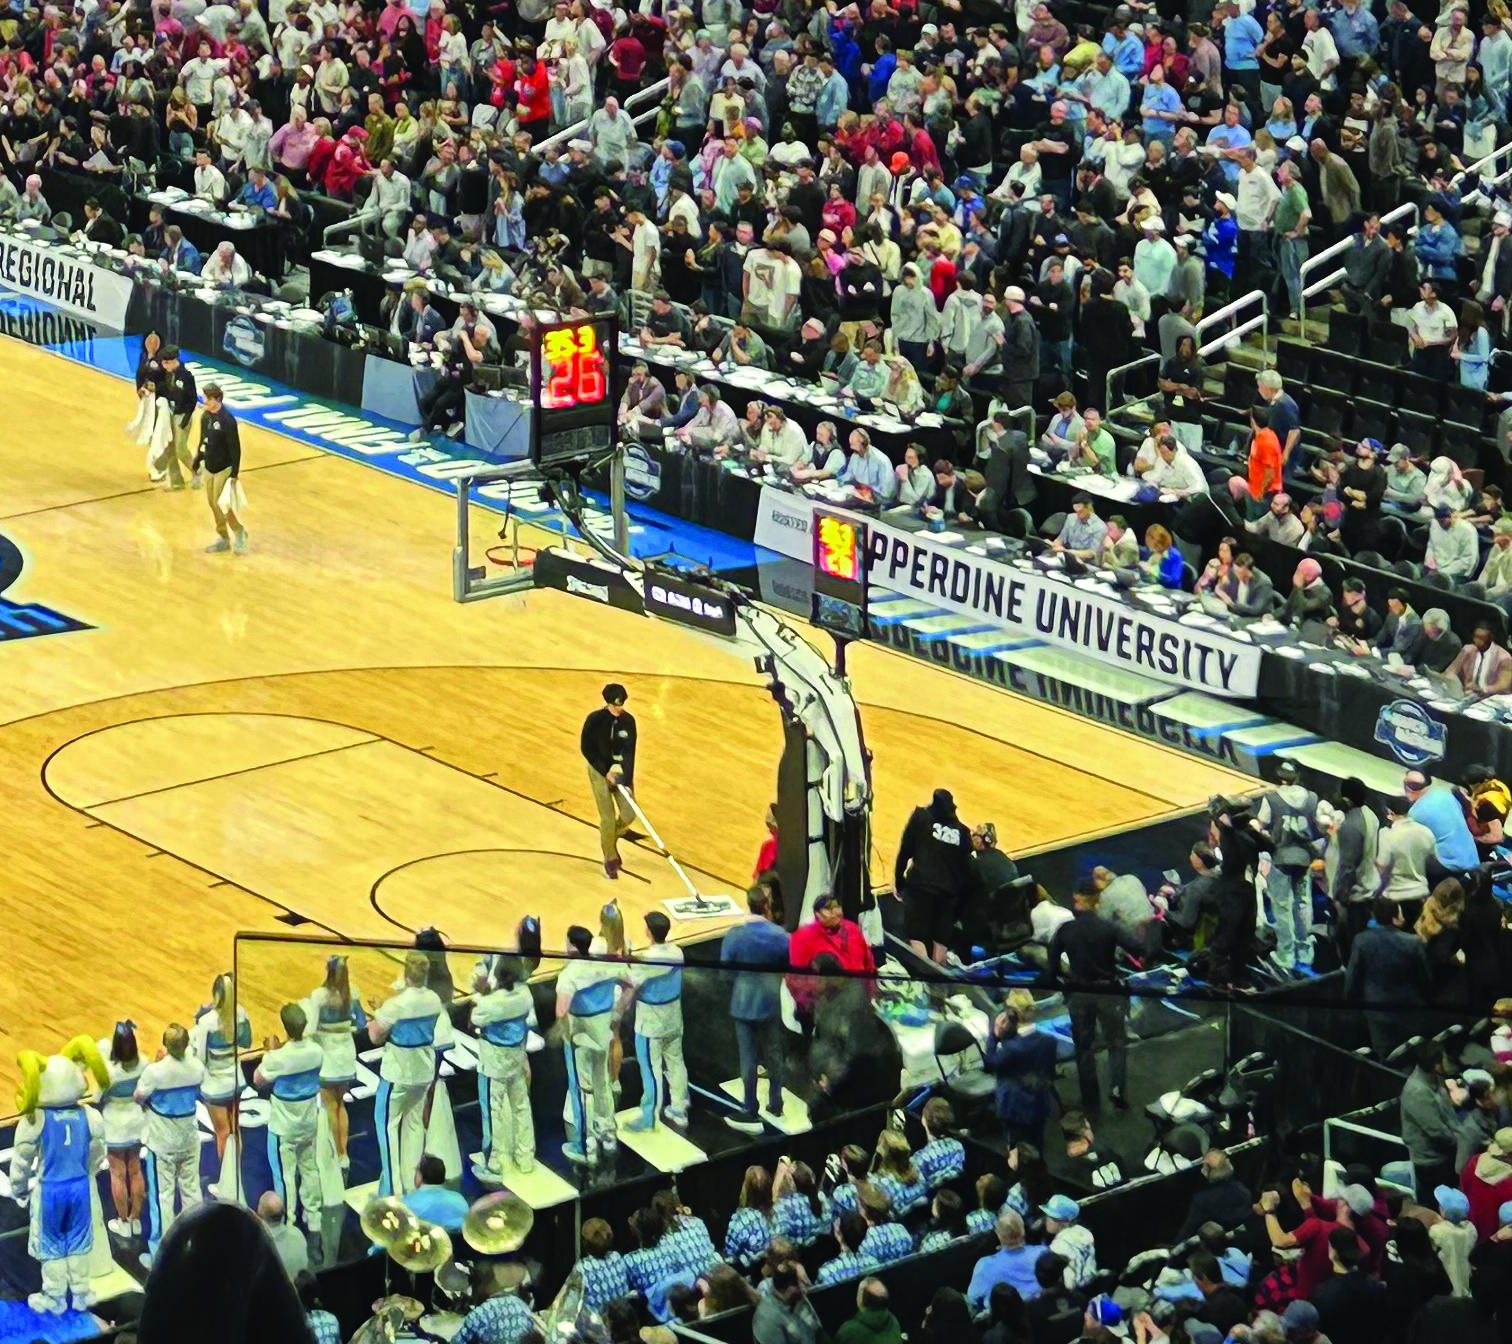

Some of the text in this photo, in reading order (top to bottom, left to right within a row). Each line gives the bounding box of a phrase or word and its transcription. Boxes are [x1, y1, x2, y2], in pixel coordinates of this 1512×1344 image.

[869, 528, 1025, 624] PPERDINE
[1035, 589, 1243, 693] UNIVERSITY
[63, 1123, 74, 1147] 1
